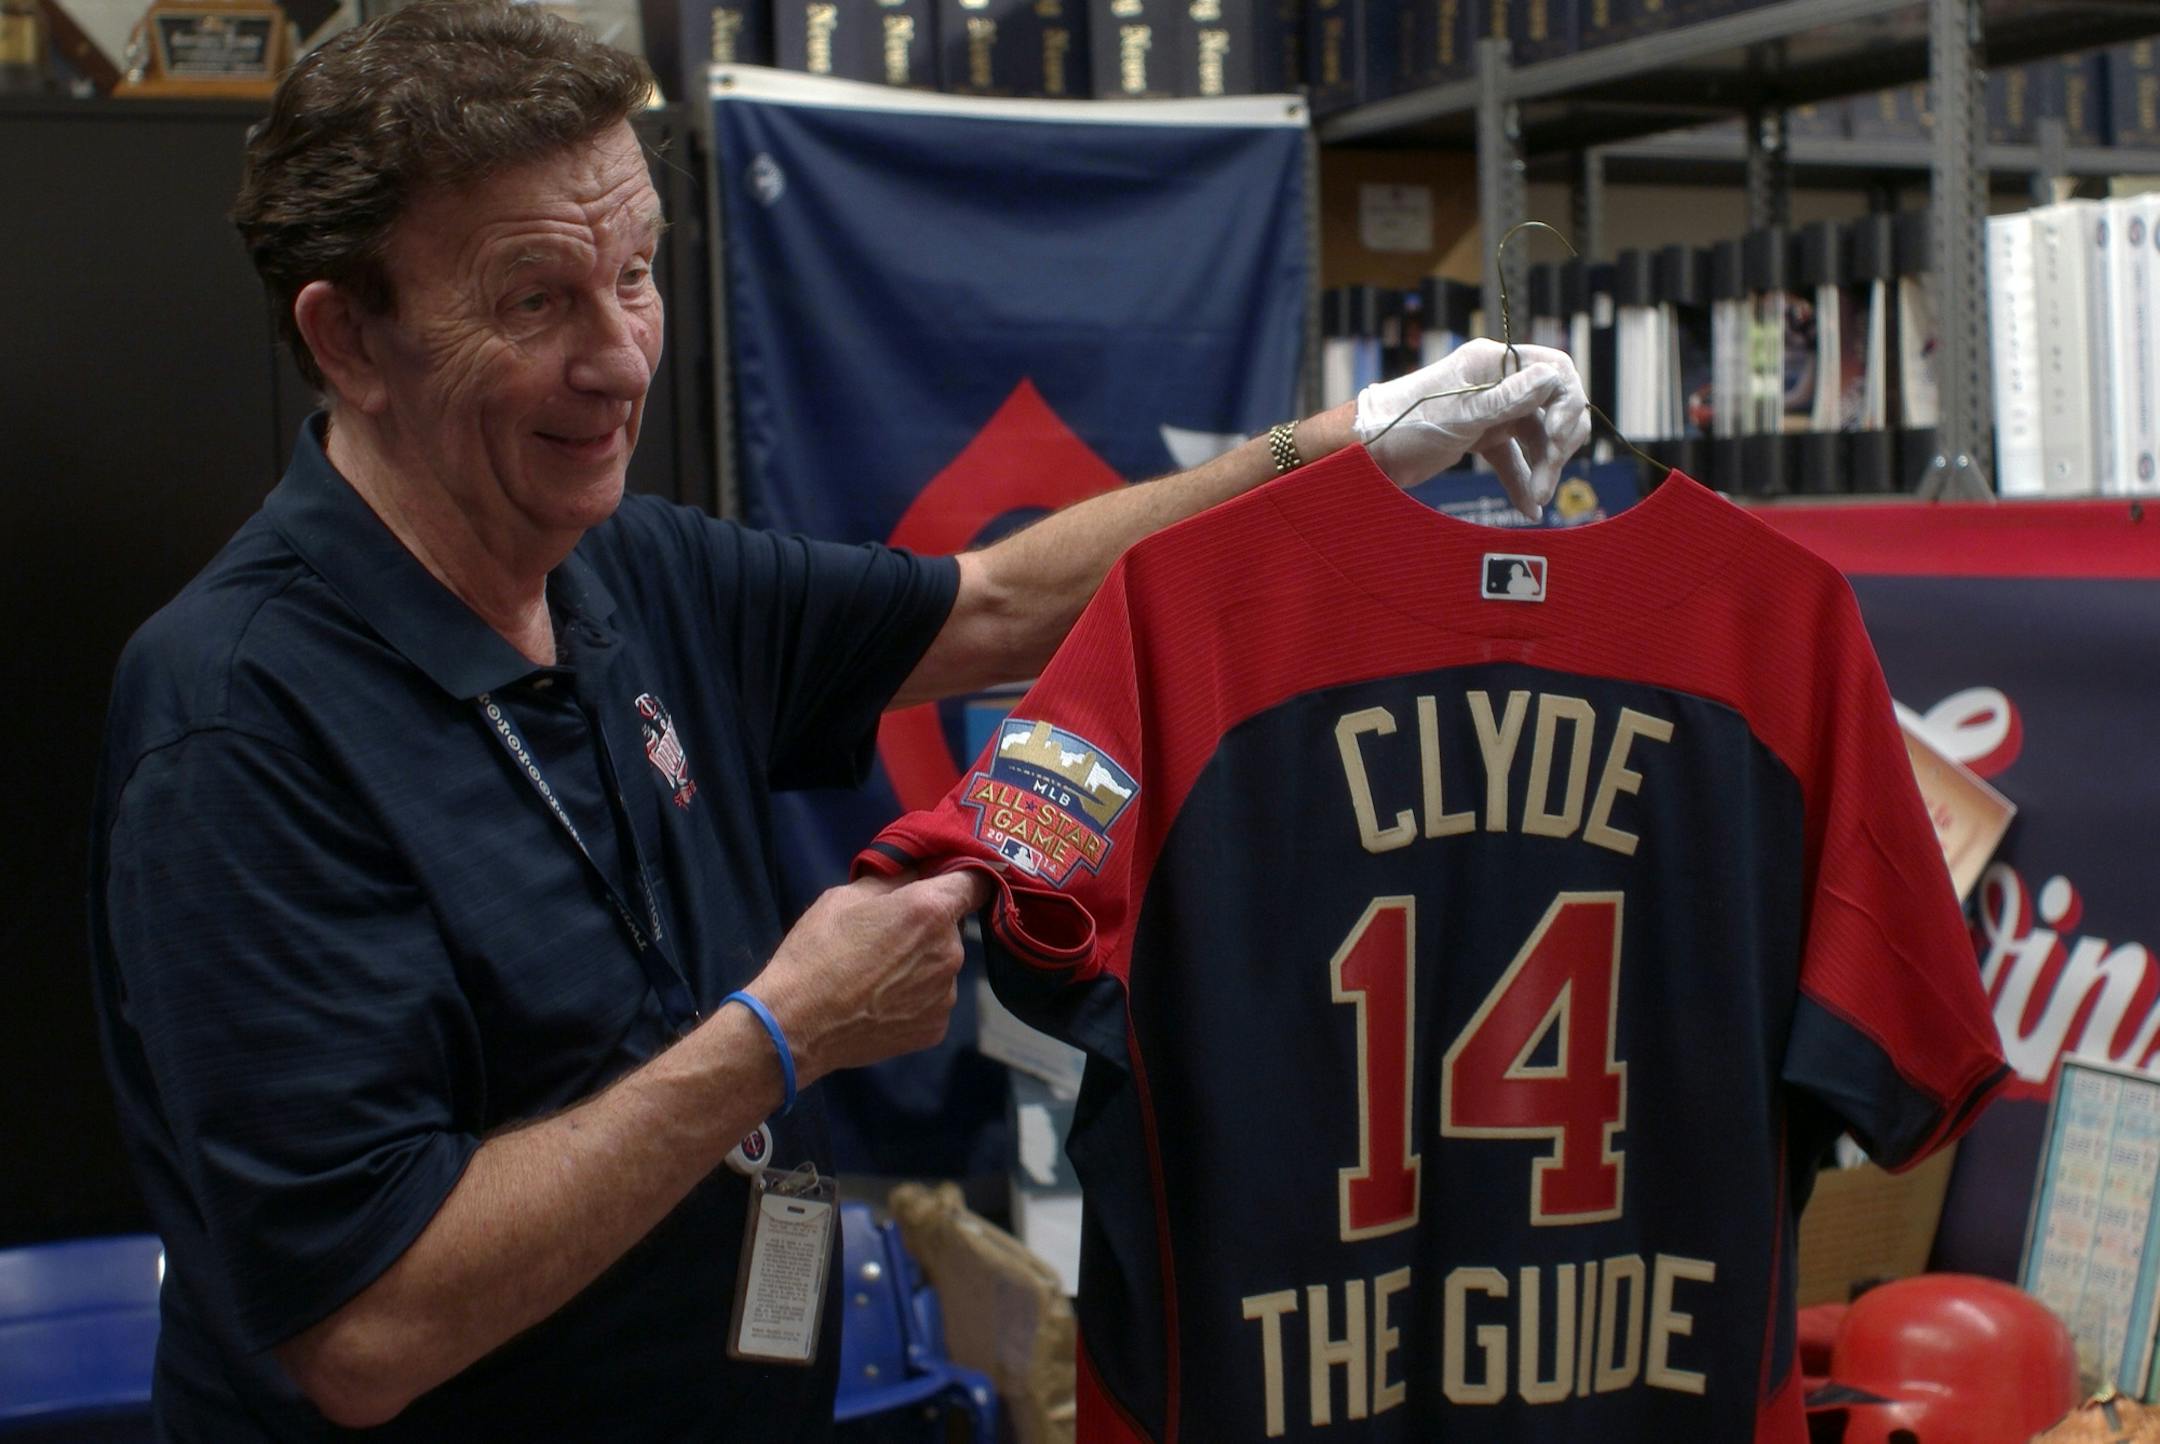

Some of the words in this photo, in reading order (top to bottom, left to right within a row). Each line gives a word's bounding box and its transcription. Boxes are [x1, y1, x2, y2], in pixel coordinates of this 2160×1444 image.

[1032, 779, 1071, 806] MLB
[1335, 690, 1674, 856] CLYDE
[975, 783, 1026, 814] ALL
[1036, 803, 1100, 857] STAR
[986, 828, 1004, 842] 20
[992, 808, 1070, 863] GAME
[1329, 890, 1627, 1242] 14
[1241, 1265, 1412, 1438] THE
[1442, 1251, 1716, 1405] GUIDE
